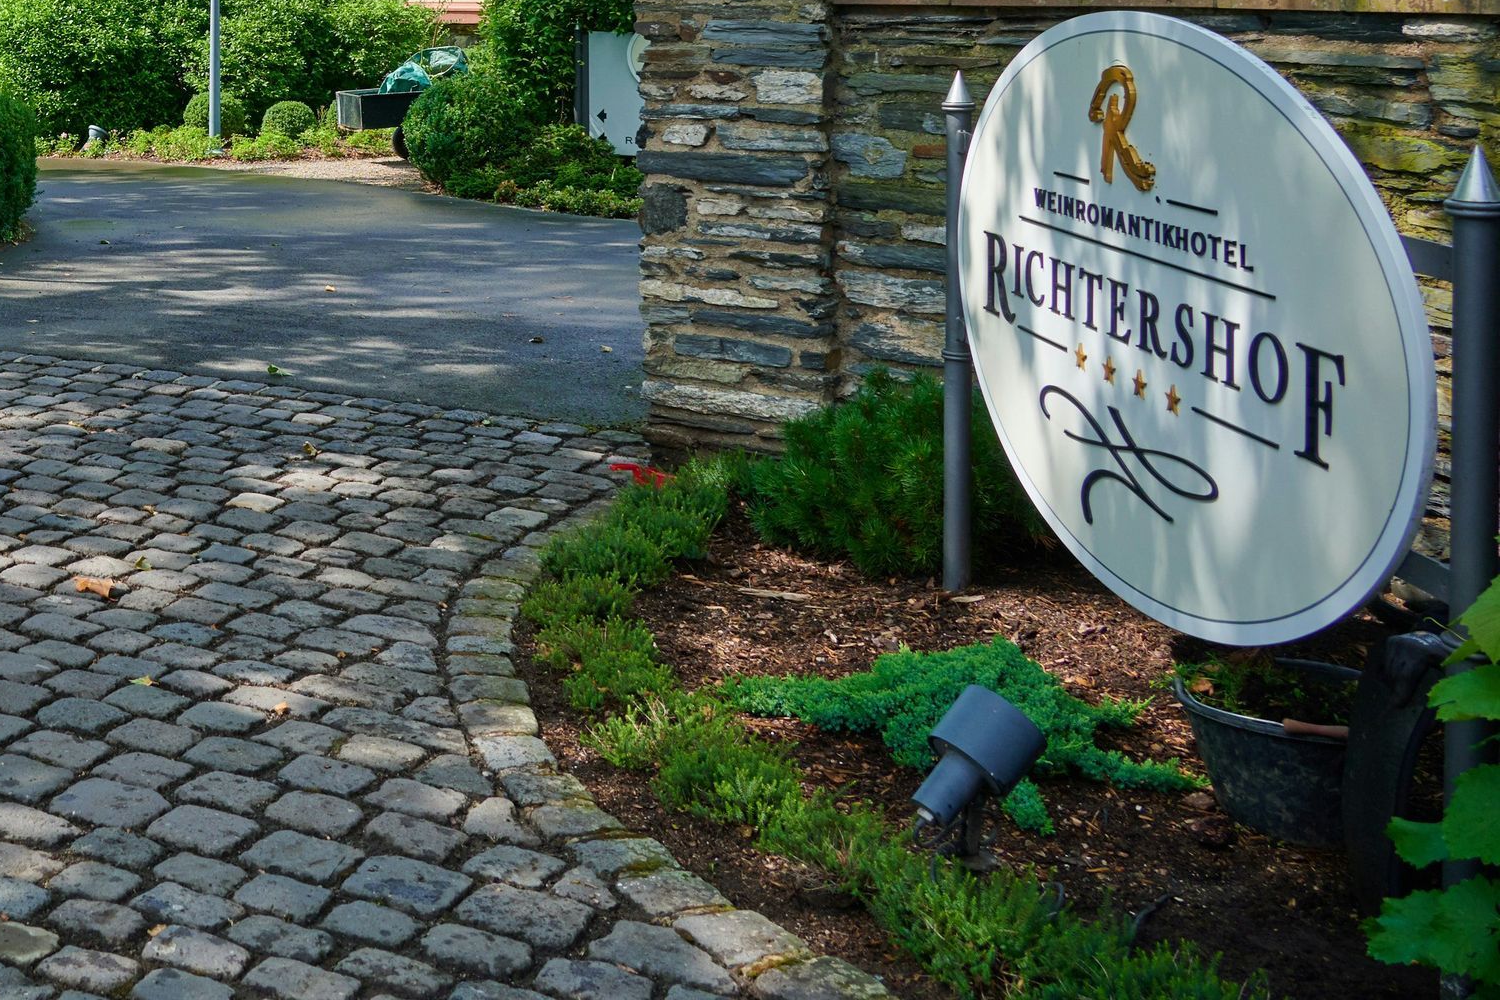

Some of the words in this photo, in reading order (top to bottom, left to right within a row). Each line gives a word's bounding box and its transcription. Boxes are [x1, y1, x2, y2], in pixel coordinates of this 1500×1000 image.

[1088, 65, 1157, 191] R
[1033, 186, 1255, 273] WEINROMANTIKHOTEL
[983, 230, 1346, 471] RICHTERSHOF
